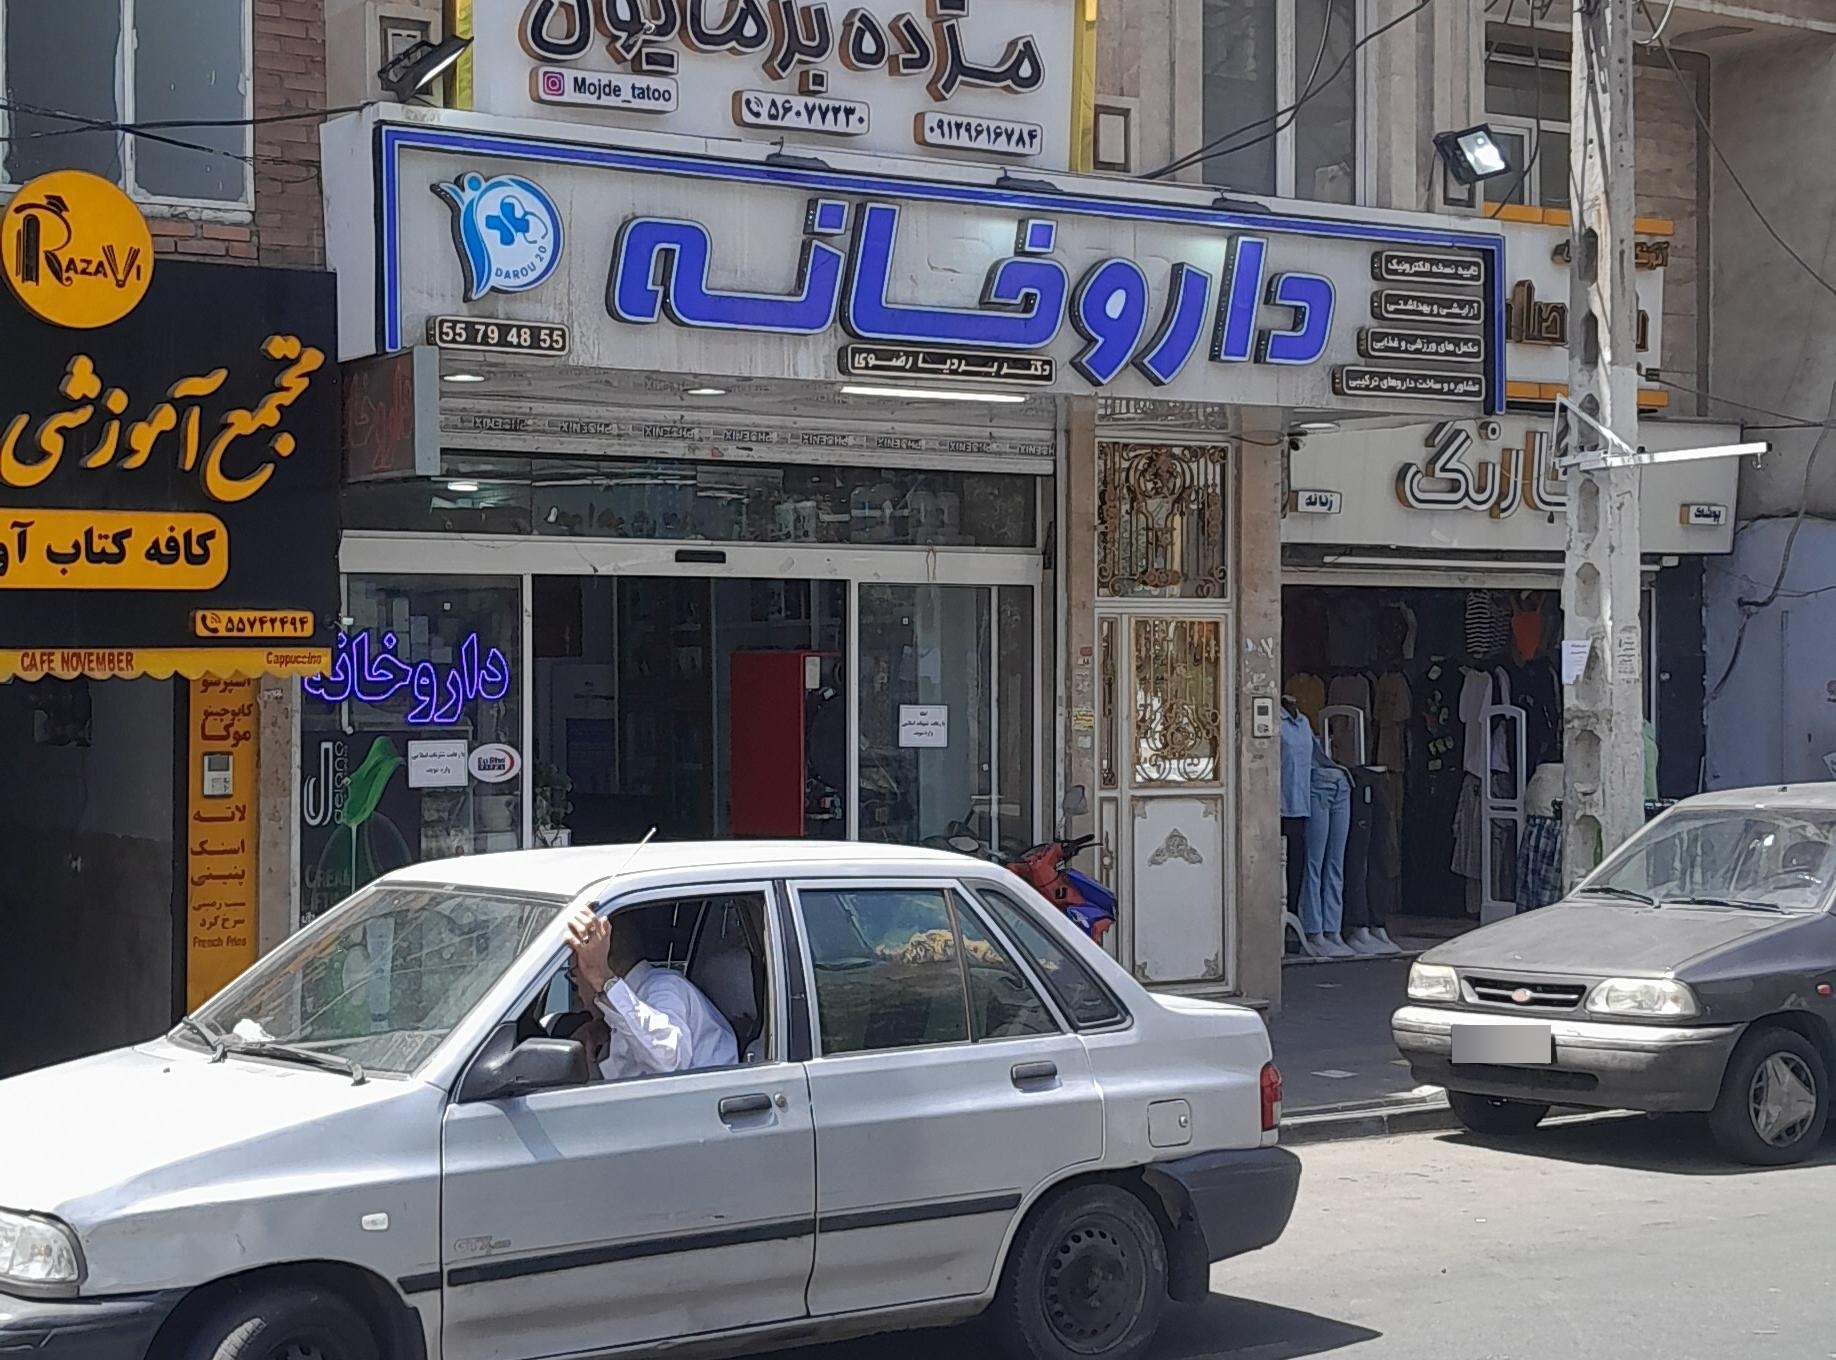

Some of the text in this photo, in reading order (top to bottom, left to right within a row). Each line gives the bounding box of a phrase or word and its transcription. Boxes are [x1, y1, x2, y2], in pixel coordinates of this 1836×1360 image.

[573, 76, 672, 104] Mojde_tatoo
[767, 99, 866, 128] ۵۶۰۷۷۲۳۰
[495, 245, 547, 280] DAROU 20
[1388, 258, 1478, 277] تایید نسخه الکترونیک
[610, 197, 1338, 386] داروخانه
[1386, 299, 1478, 317] آرایشی و بهداشتی
[442, 322, 563, 348] 55 79 48 55
[1373, 336, 1479, 354] مکمل های ورزشی و غذایی
[854, 351, 1050, 376] دکتر بردیا رضوی
[1349, 374, 1479, 393] مشاوره و ساخت داروهای ترکیبی
[0, 334, 325, 502] مجتمع آموزشی
[1305, 493, 1333, 512] زنانه
[46, 526, 133, 576] کتاب
[144, 525, 217, 566] کافه
[225, 616, 308, 632] ۵۵۷۴۲۴۹۴
[20, 651, 134, 672] CAFE NOVEMBER
[266, 651, 322, 668] Cappuccino
[200, 678, 251, 694] اسپرسو
[201, 719, 251, 748] موکا
[193, 804, 247, 822] لاته
[191, 839, 245, 856] اسنک
[191, 866, 246, 886] پنینی
[221, 914, 246, 930] سرخ
[193, 935, 247, 948] French Fries
